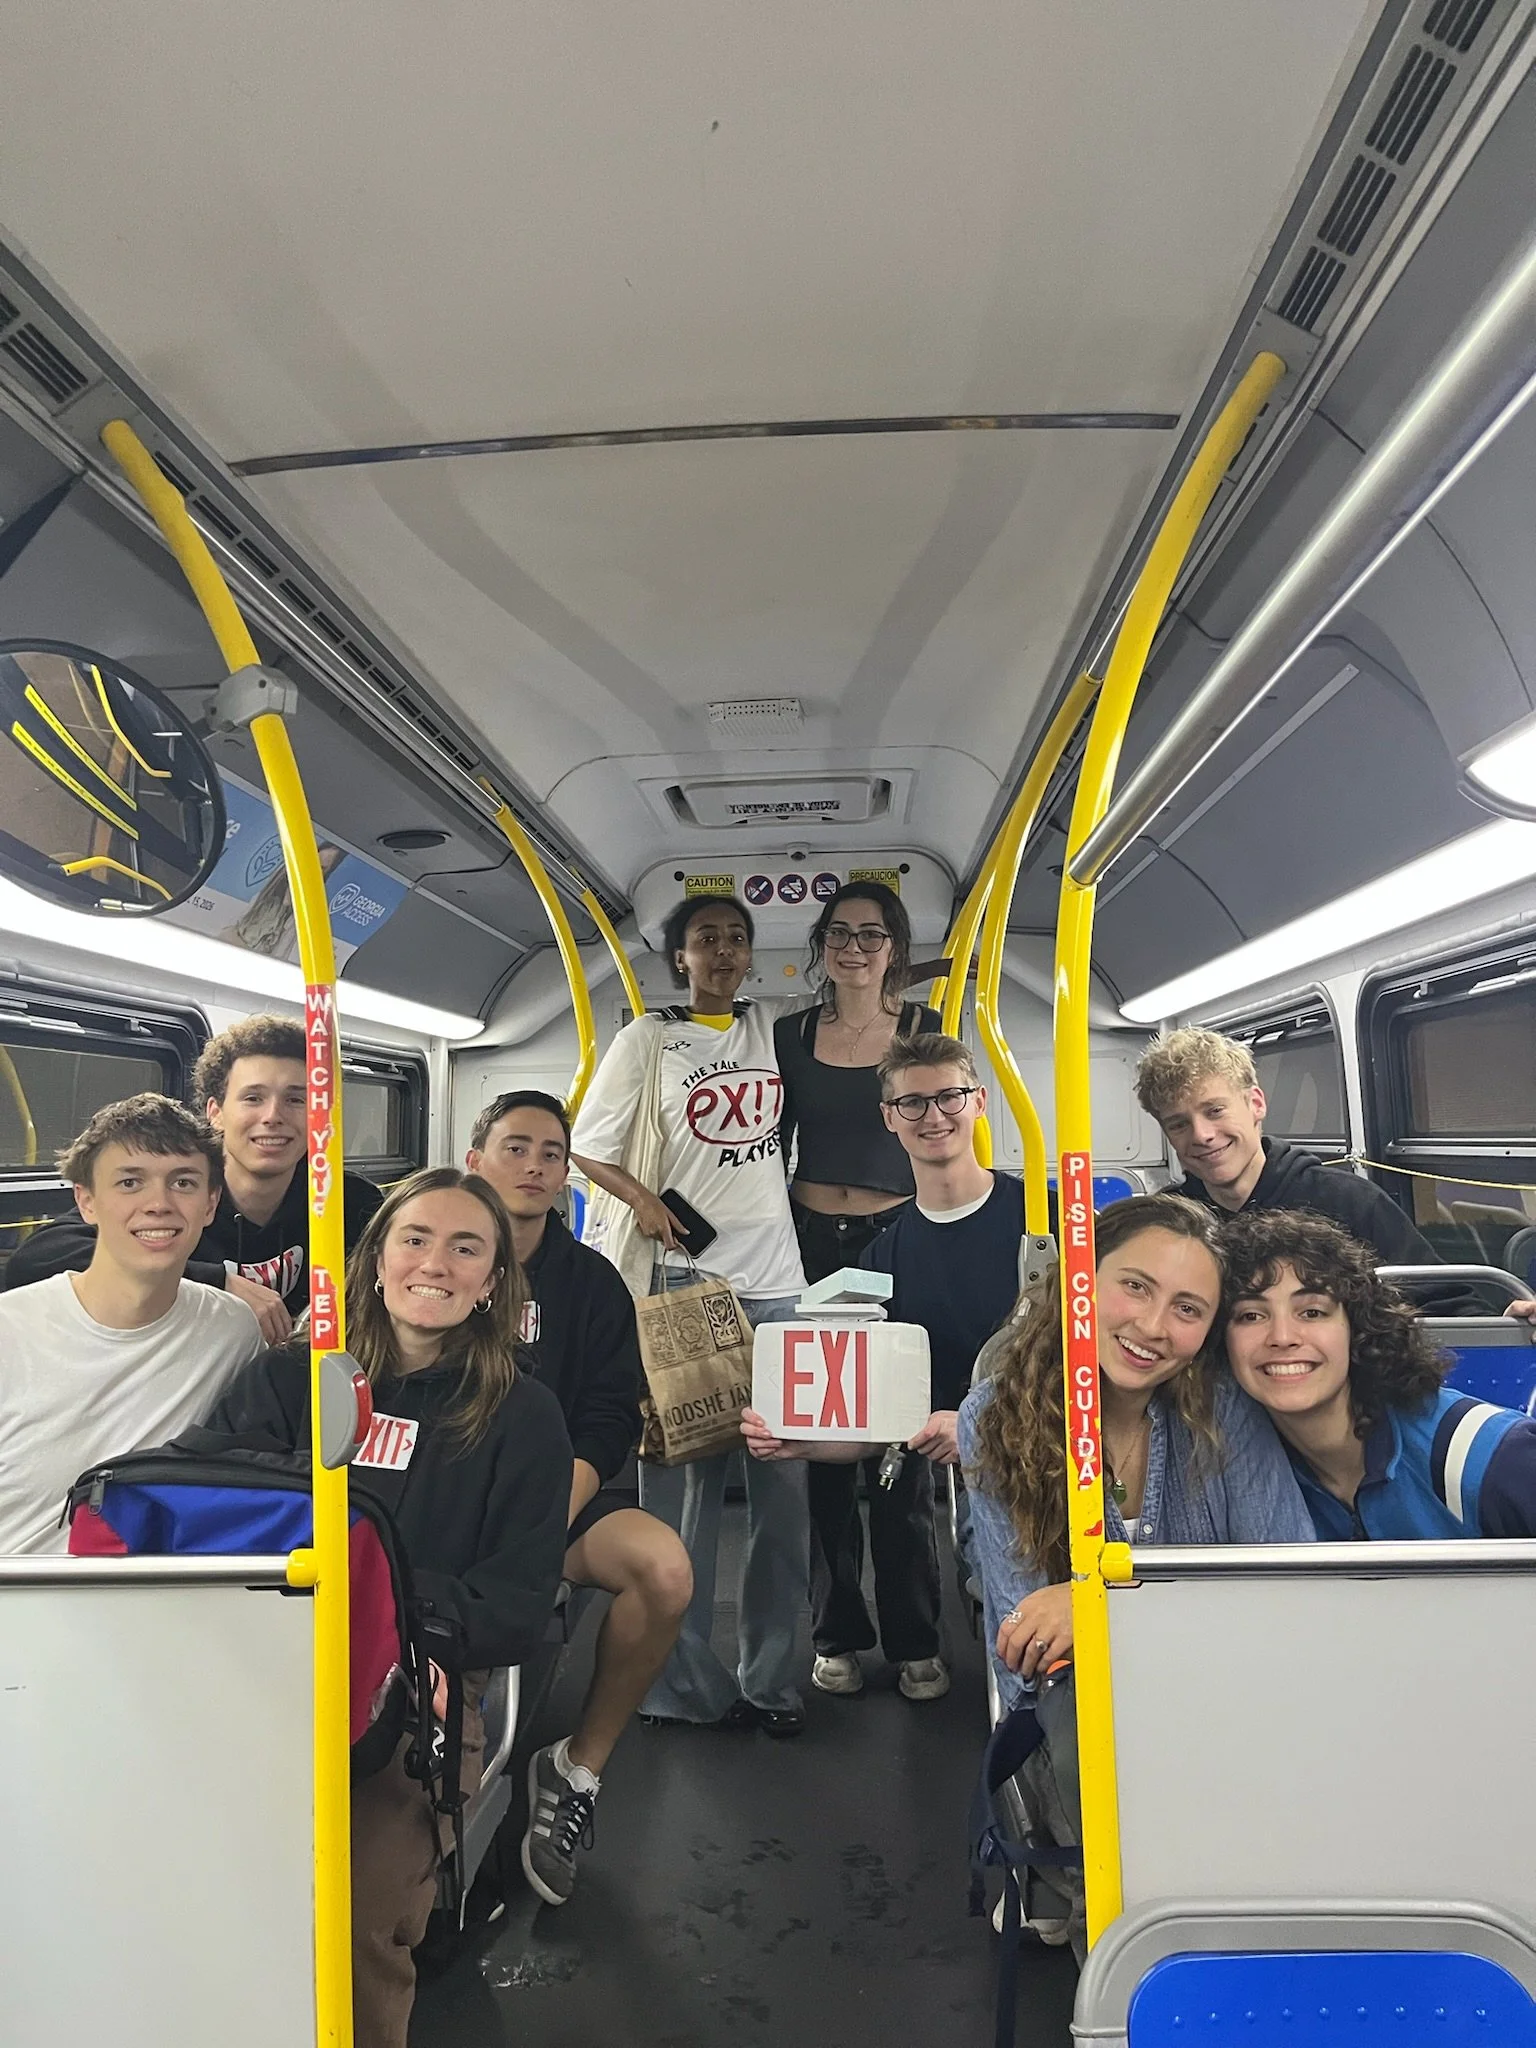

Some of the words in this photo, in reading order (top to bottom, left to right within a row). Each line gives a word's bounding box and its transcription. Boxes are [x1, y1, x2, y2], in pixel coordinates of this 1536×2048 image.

[353, 896, 386, 918] GEORGIA
[687, 877, 734, 888] CAUTION
[341, 908, 373, 926] ACCESS
[307, 993, 331, 1110] WATCH
[682, 1066, 708, 1089] THE
[710, 1060, 740, 1072] YALE
[717, 1130, 780, 1168] PLAYER
[1069, 1156, 1088, 1247] PISE
[314, 1269, 332, 1339] TEP
[1071, 1272, 1092, 1340] CON
[359, 1416, 411, 1465] XIT
[1074, 1366, 1096, 1489] CUIDA
